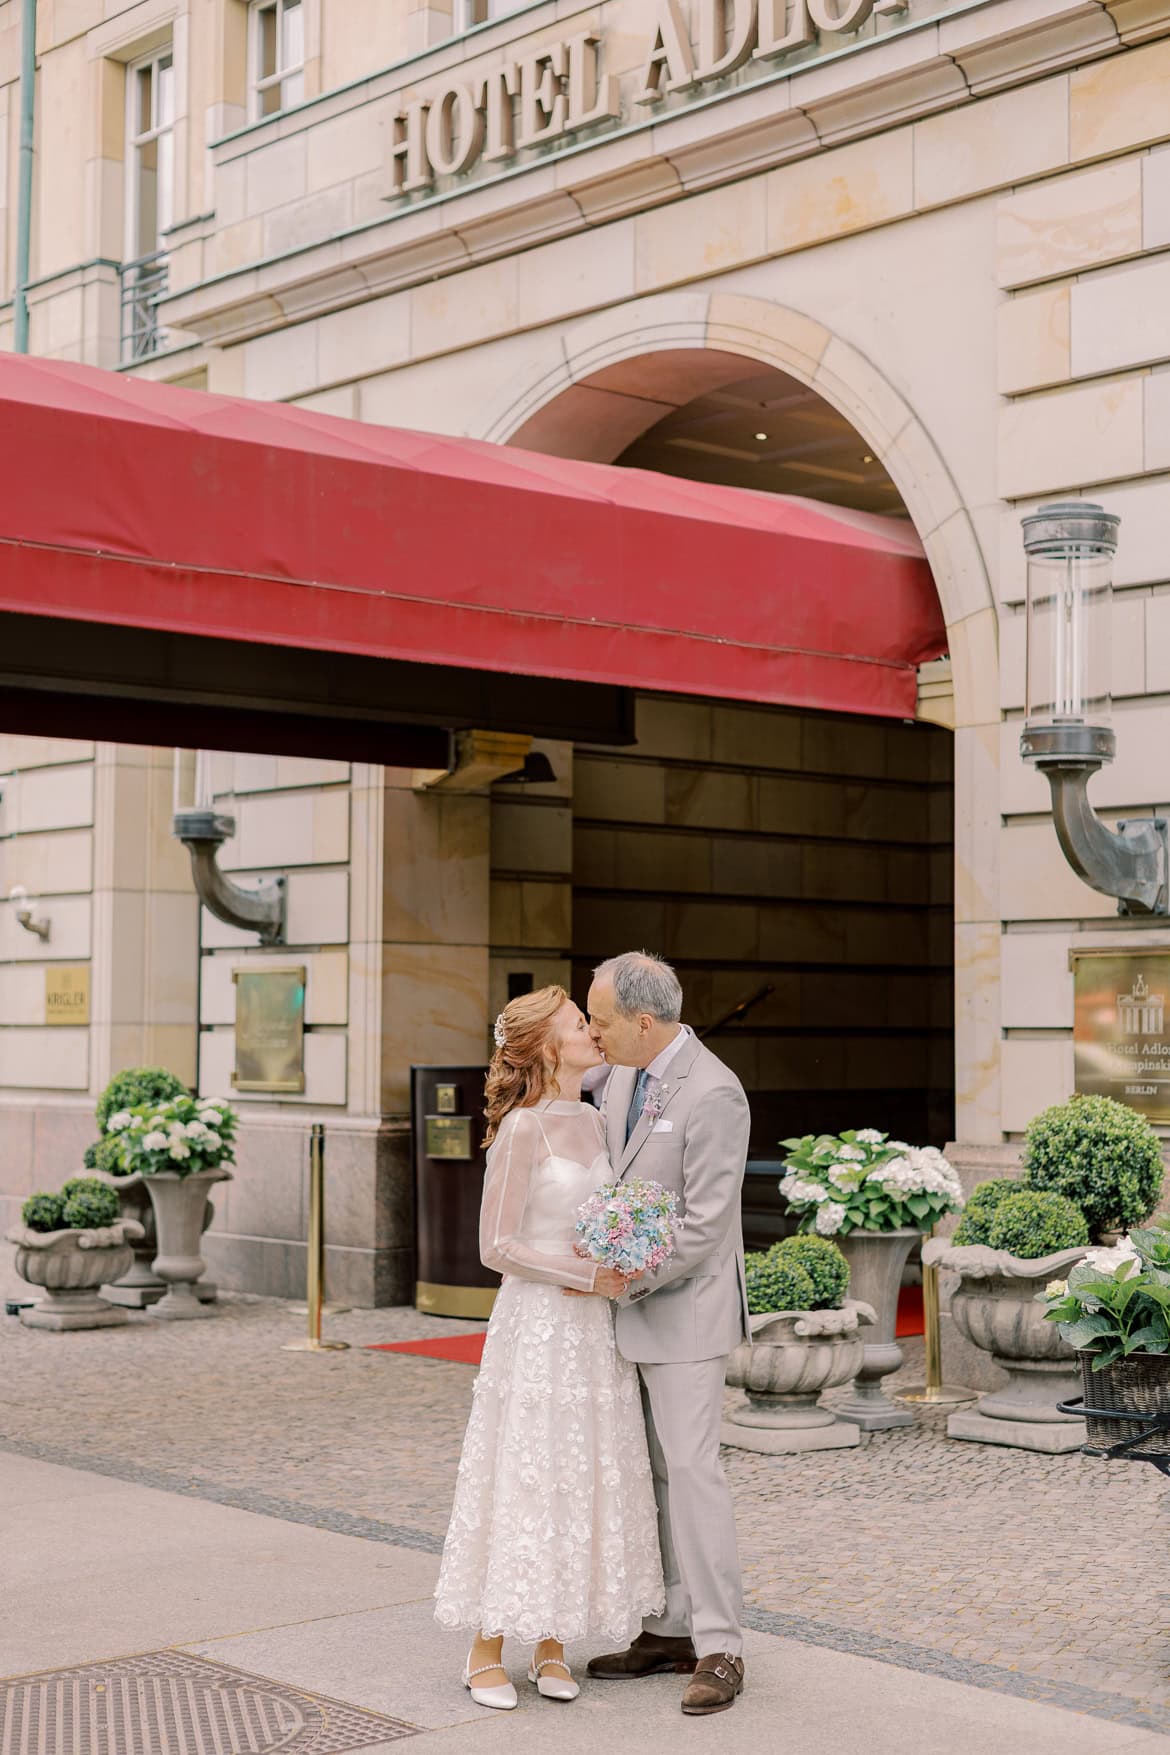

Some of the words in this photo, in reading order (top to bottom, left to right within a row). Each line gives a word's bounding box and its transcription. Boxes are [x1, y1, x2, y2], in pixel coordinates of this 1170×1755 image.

[382, 31, 621, 201] HOTEL
[47, 992, 86, 1007] KRIGLER
[1141, 1042, 1170, 1055] Adlo
[1125, 1085, 1158, 1095] BERLIN
